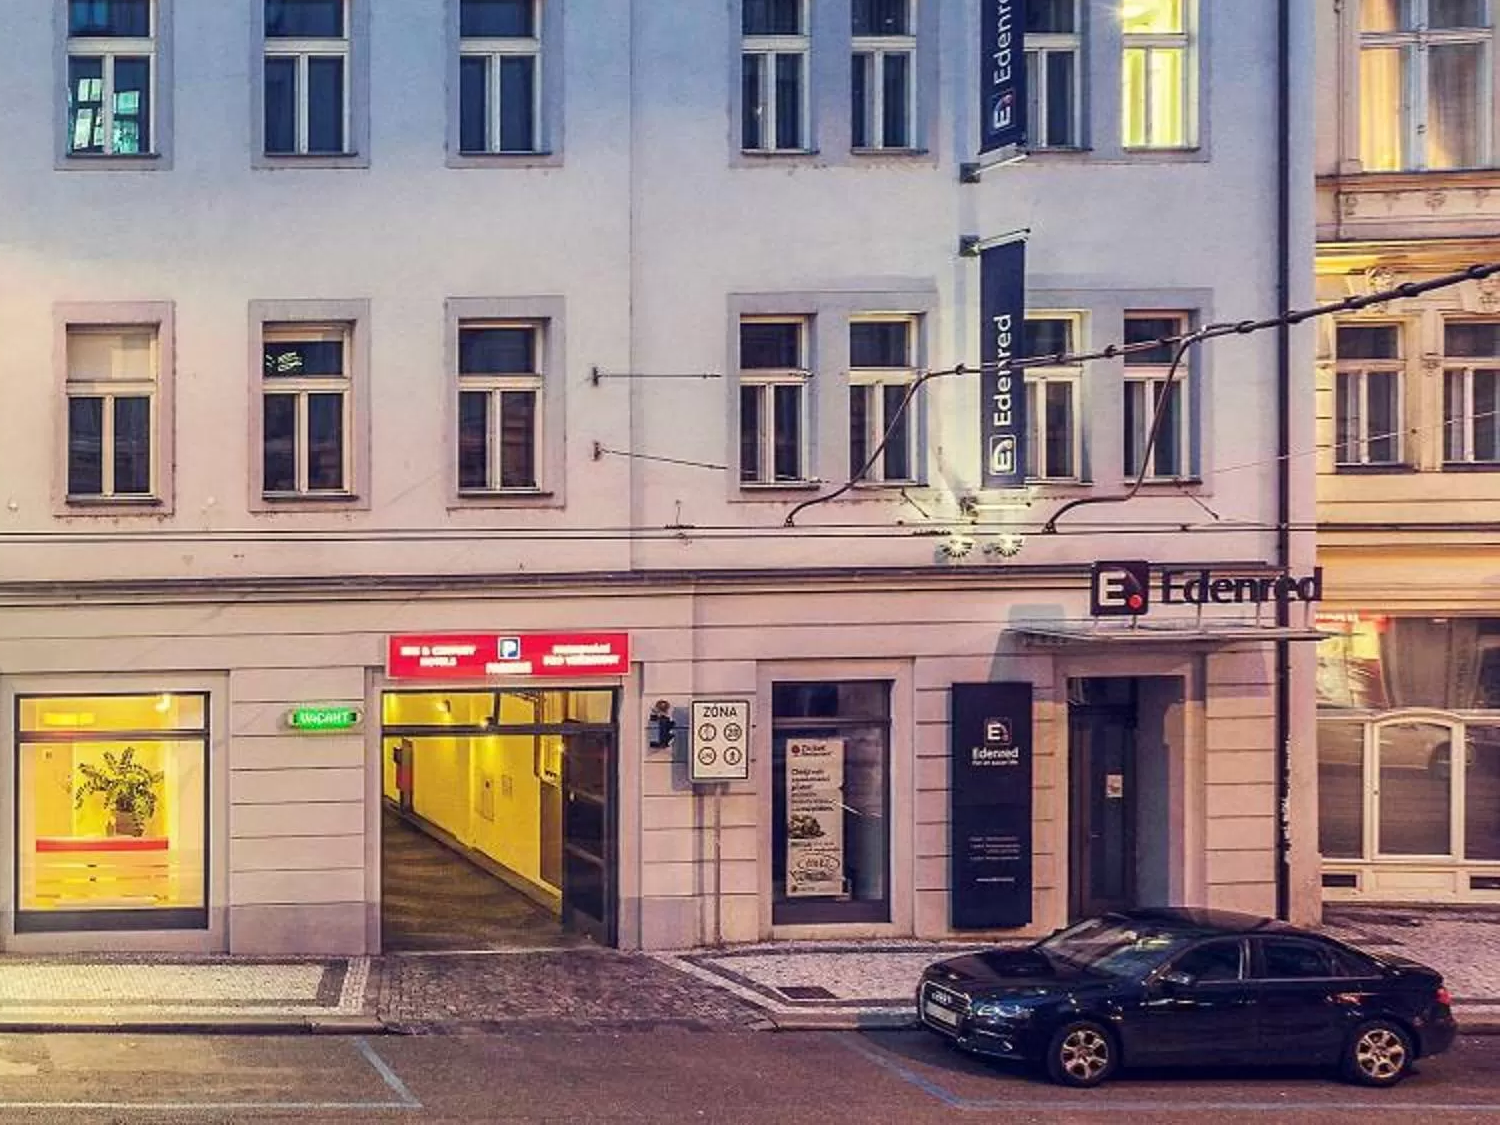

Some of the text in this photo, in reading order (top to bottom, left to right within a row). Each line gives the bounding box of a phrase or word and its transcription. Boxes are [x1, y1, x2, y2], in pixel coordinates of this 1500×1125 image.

[1161, 566, 1323, 604] Edenred
[300, 711, 349, 724] VACANT
[972, 747, 1019, 760] Edenred
